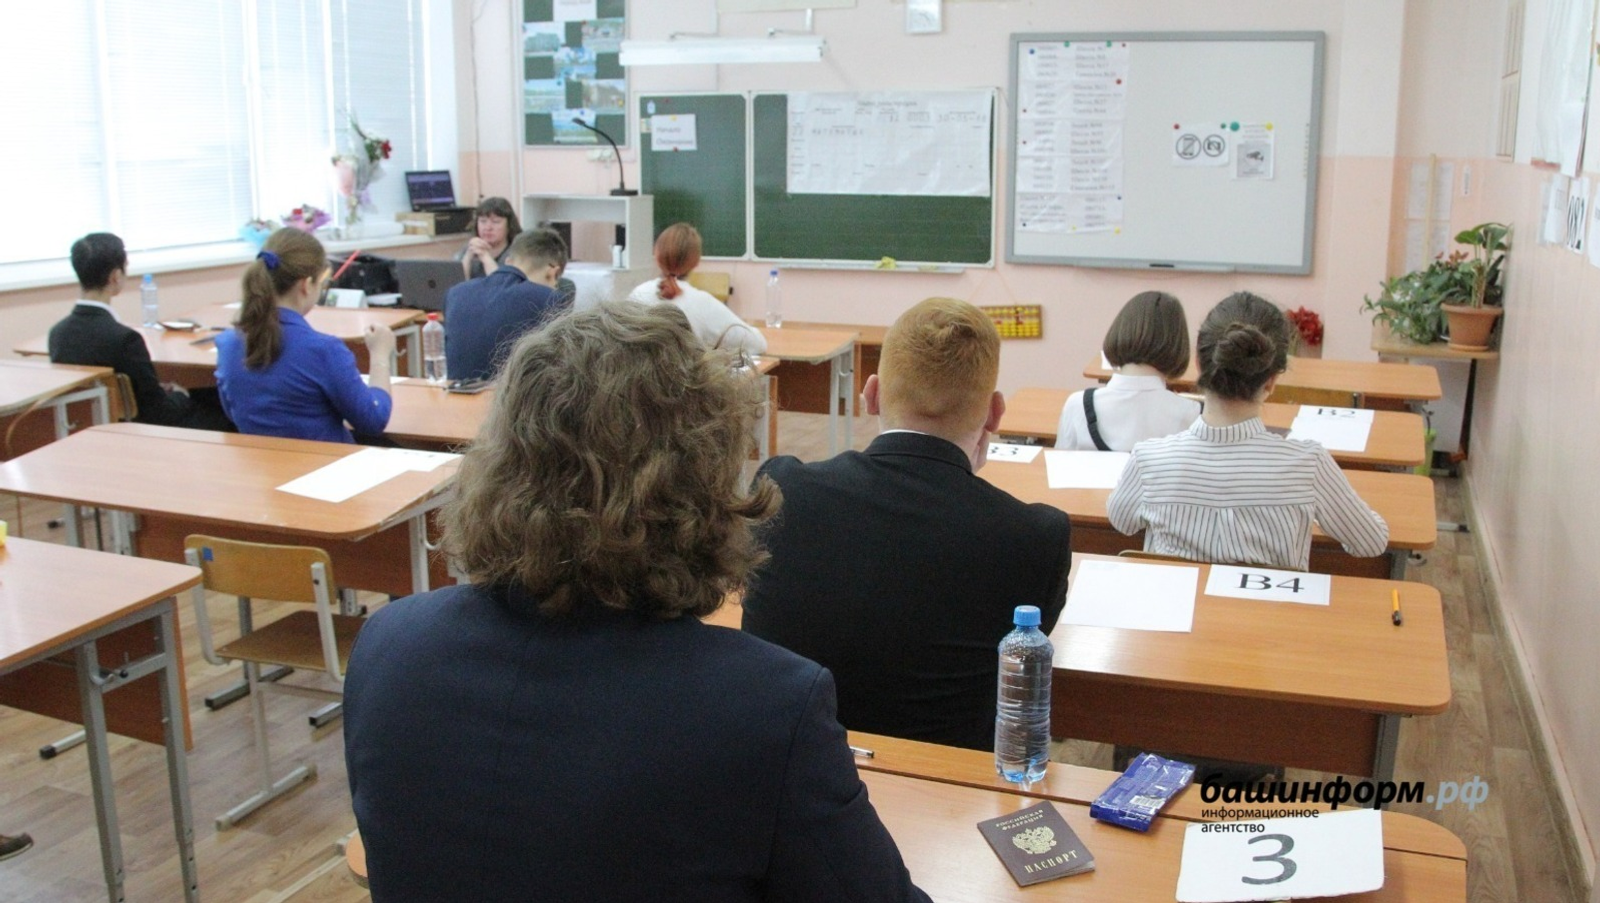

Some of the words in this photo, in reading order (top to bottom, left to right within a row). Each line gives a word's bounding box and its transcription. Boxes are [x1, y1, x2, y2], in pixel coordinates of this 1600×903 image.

[995, 809, 1044, 828] РОССИЙСКАЯ
[1002, 814, 1044, 831] ФЕДЕРАЦИЯ
[1024, 850, 1078, 874] ПАСПОРТ
[1241, 833, 1298, 885] 3
